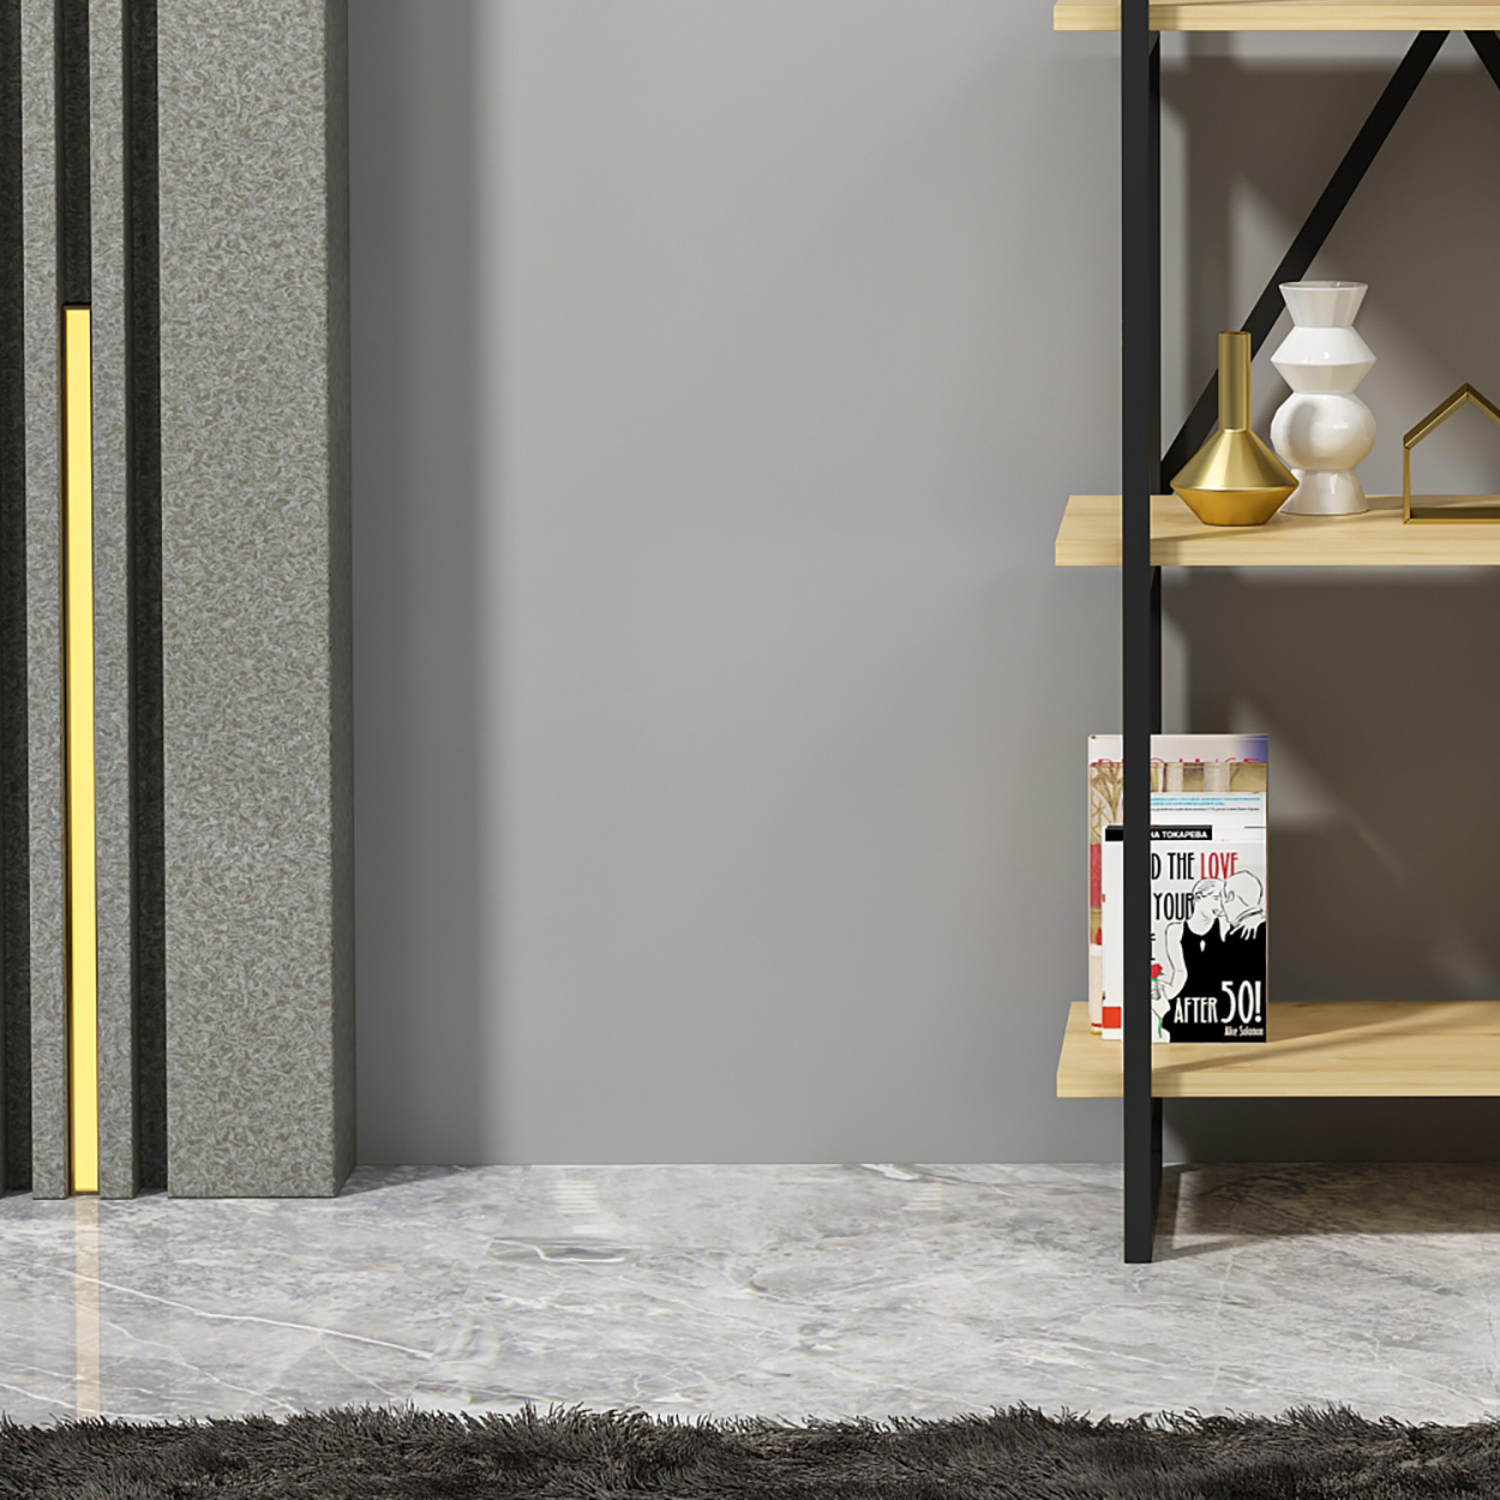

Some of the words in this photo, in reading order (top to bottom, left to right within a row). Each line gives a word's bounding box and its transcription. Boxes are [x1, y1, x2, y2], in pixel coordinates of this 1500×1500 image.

[1167, 852, 1195, 880] THE
[1200, 852, 1239, 880] LOVE
[1174, 996, 1218, 1024] AFTER
[1220, 980, 1262, 1025] 50!
